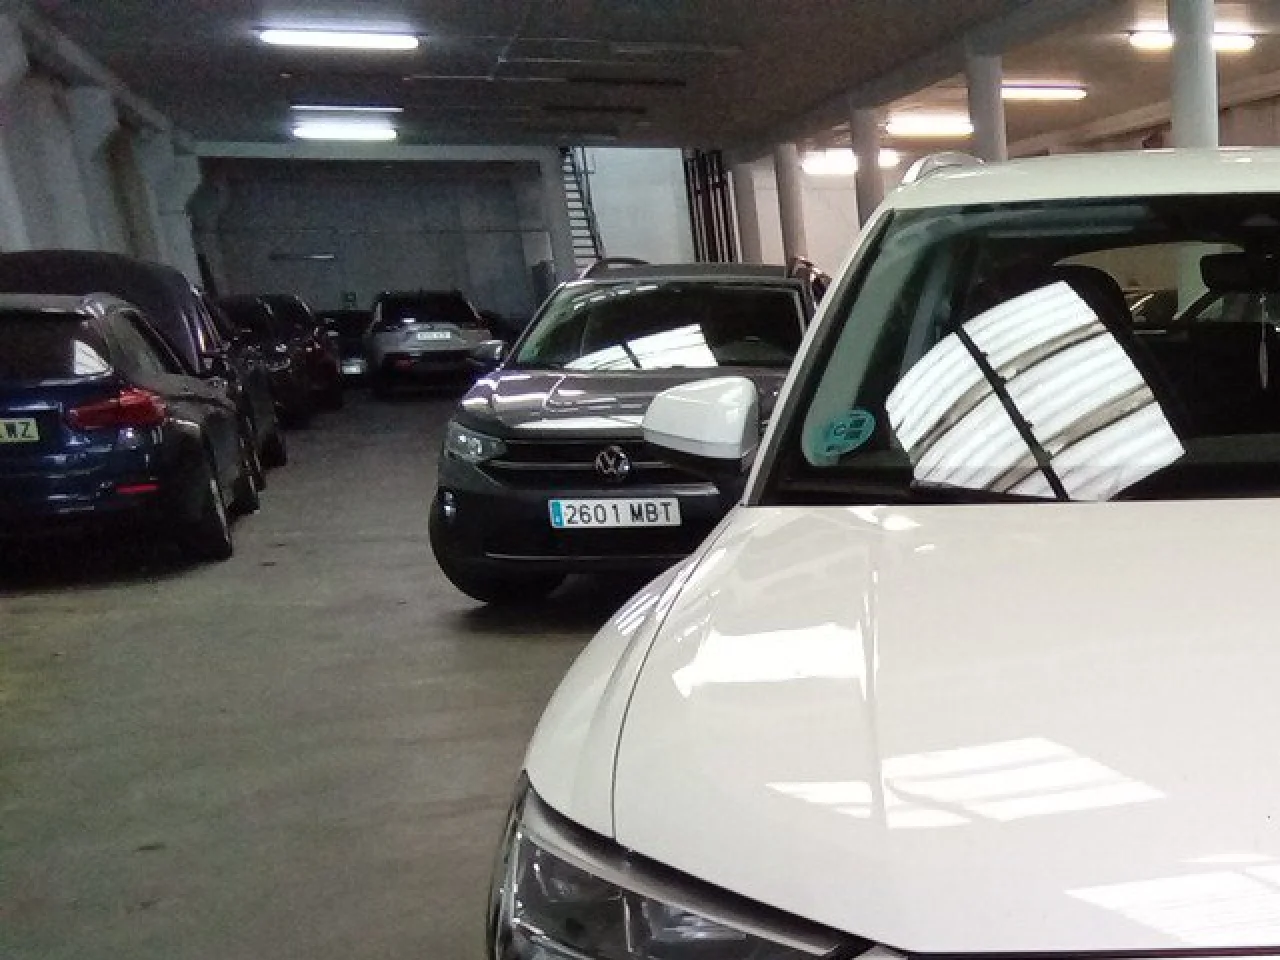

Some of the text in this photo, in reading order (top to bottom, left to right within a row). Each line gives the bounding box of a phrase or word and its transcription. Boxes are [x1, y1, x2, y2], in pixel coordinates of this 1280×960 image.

[0, 421, 35, 438] WZ
[565, 503, 621, 524] 2601
[629, 501, 673, 523] MBT
